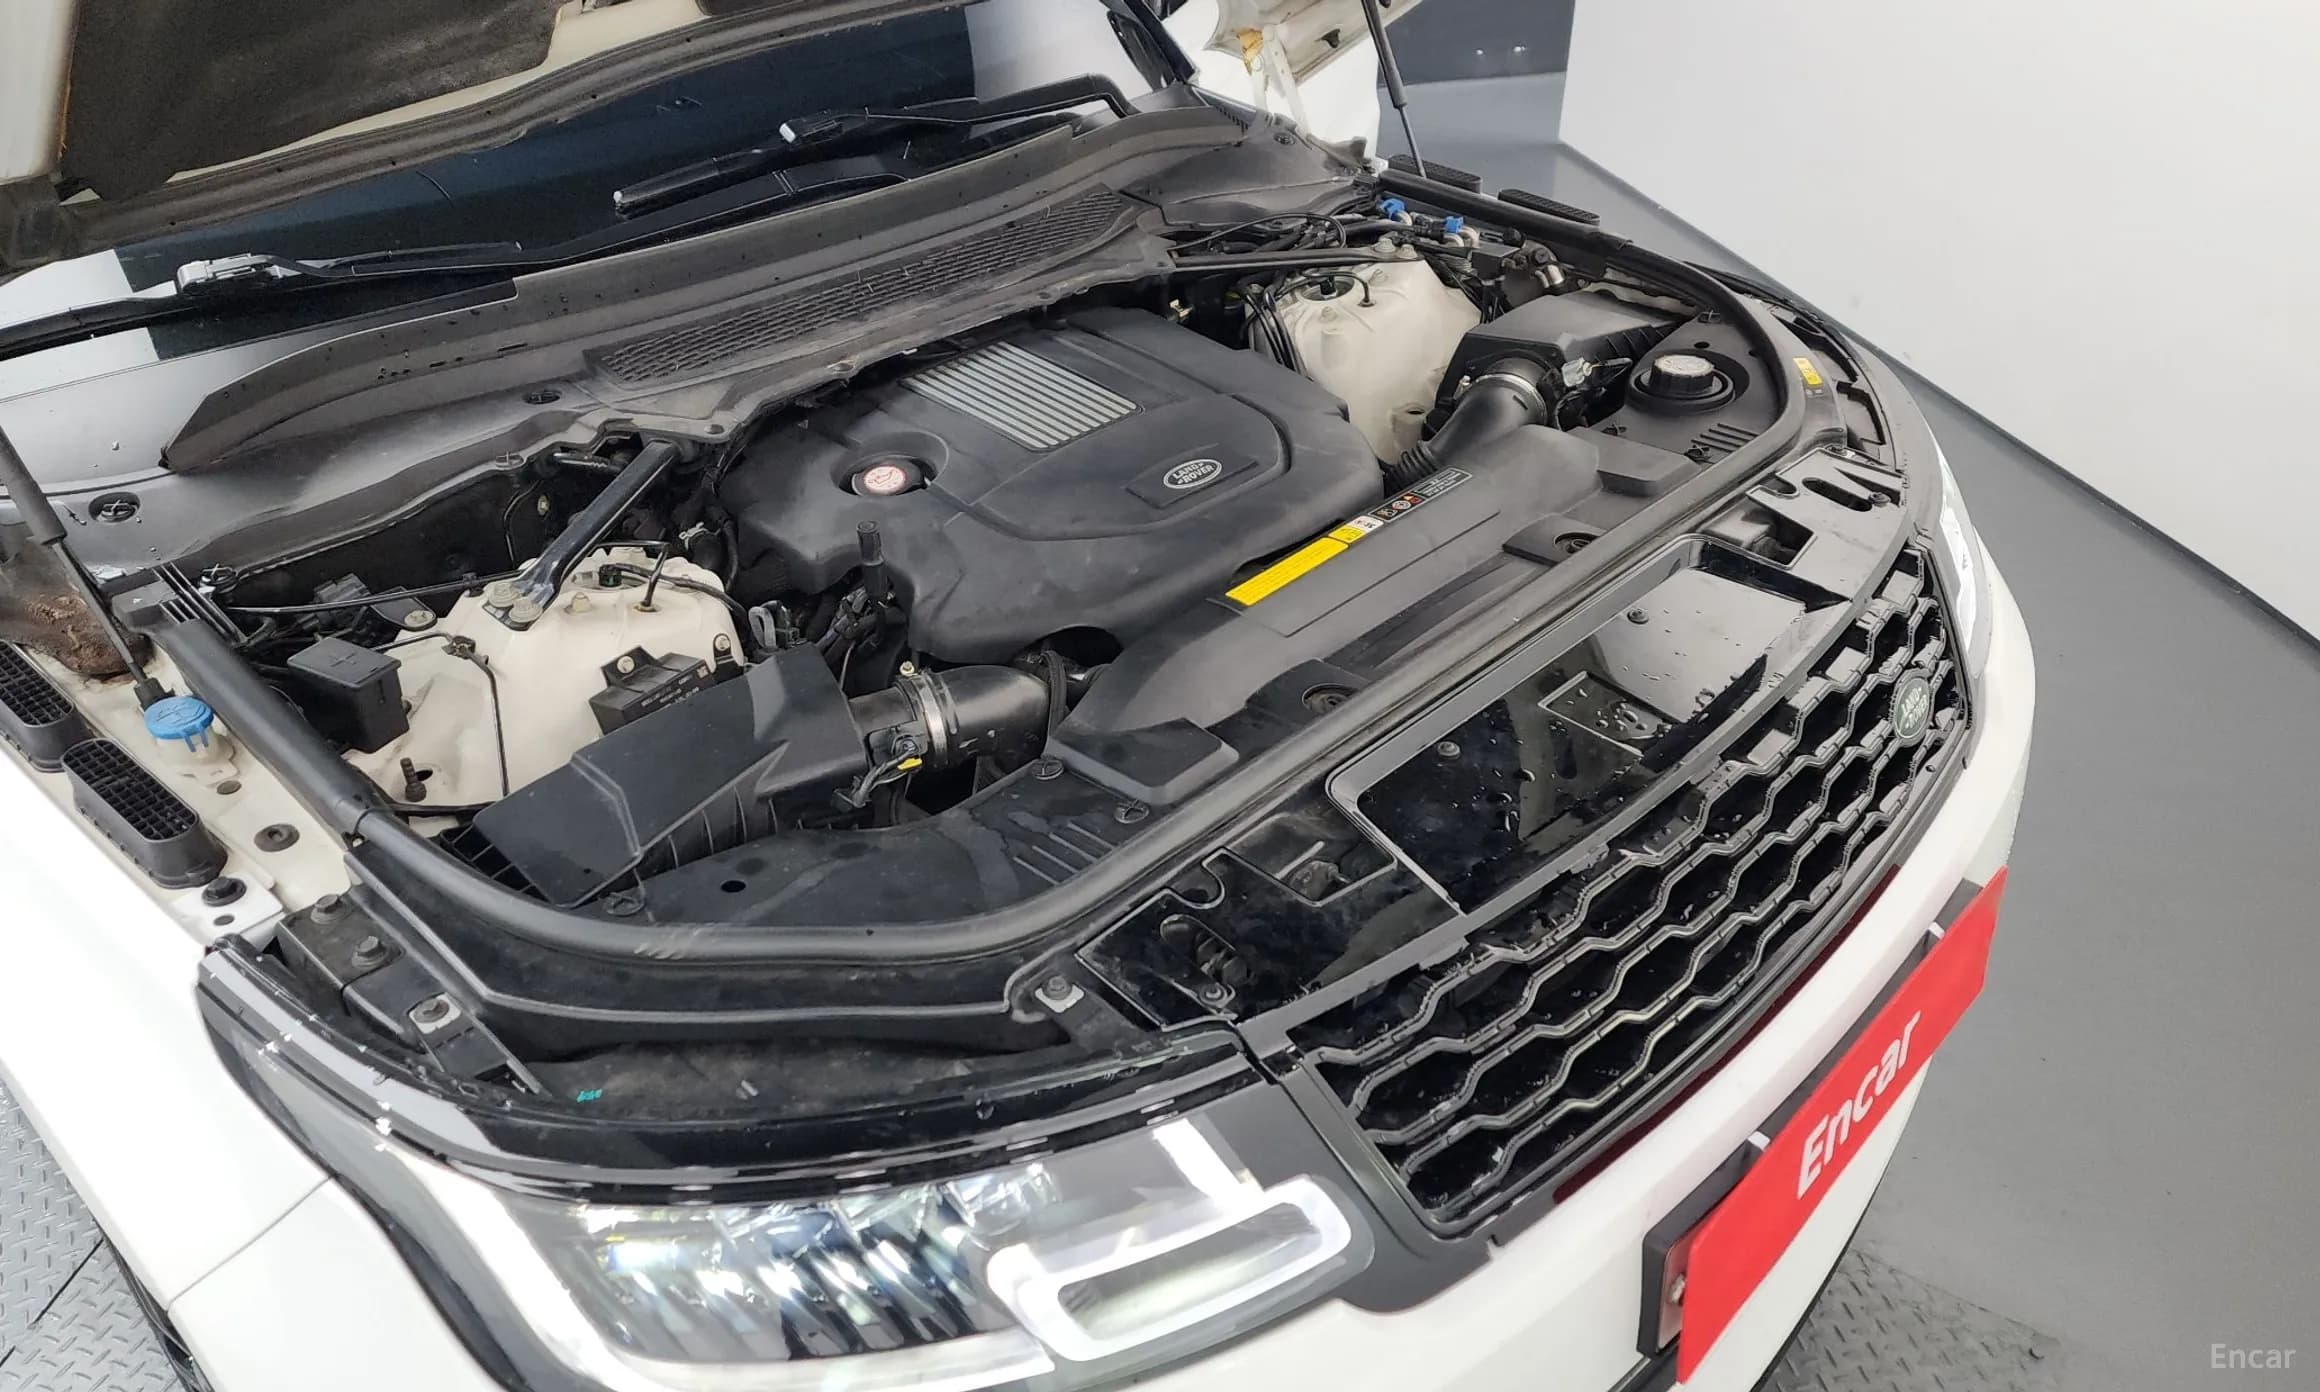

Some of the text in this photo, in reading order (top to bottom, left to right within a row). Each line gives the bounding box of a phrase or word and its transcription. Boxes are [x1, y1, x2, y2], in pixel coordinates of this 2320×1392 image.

[1171, 463, 1199, 479] LAND
[1182, 464, 1215, 483] ROVER
[1901, 687, 1920, 718] LAND
[1797, 1010, 1921, 1200] Encar
